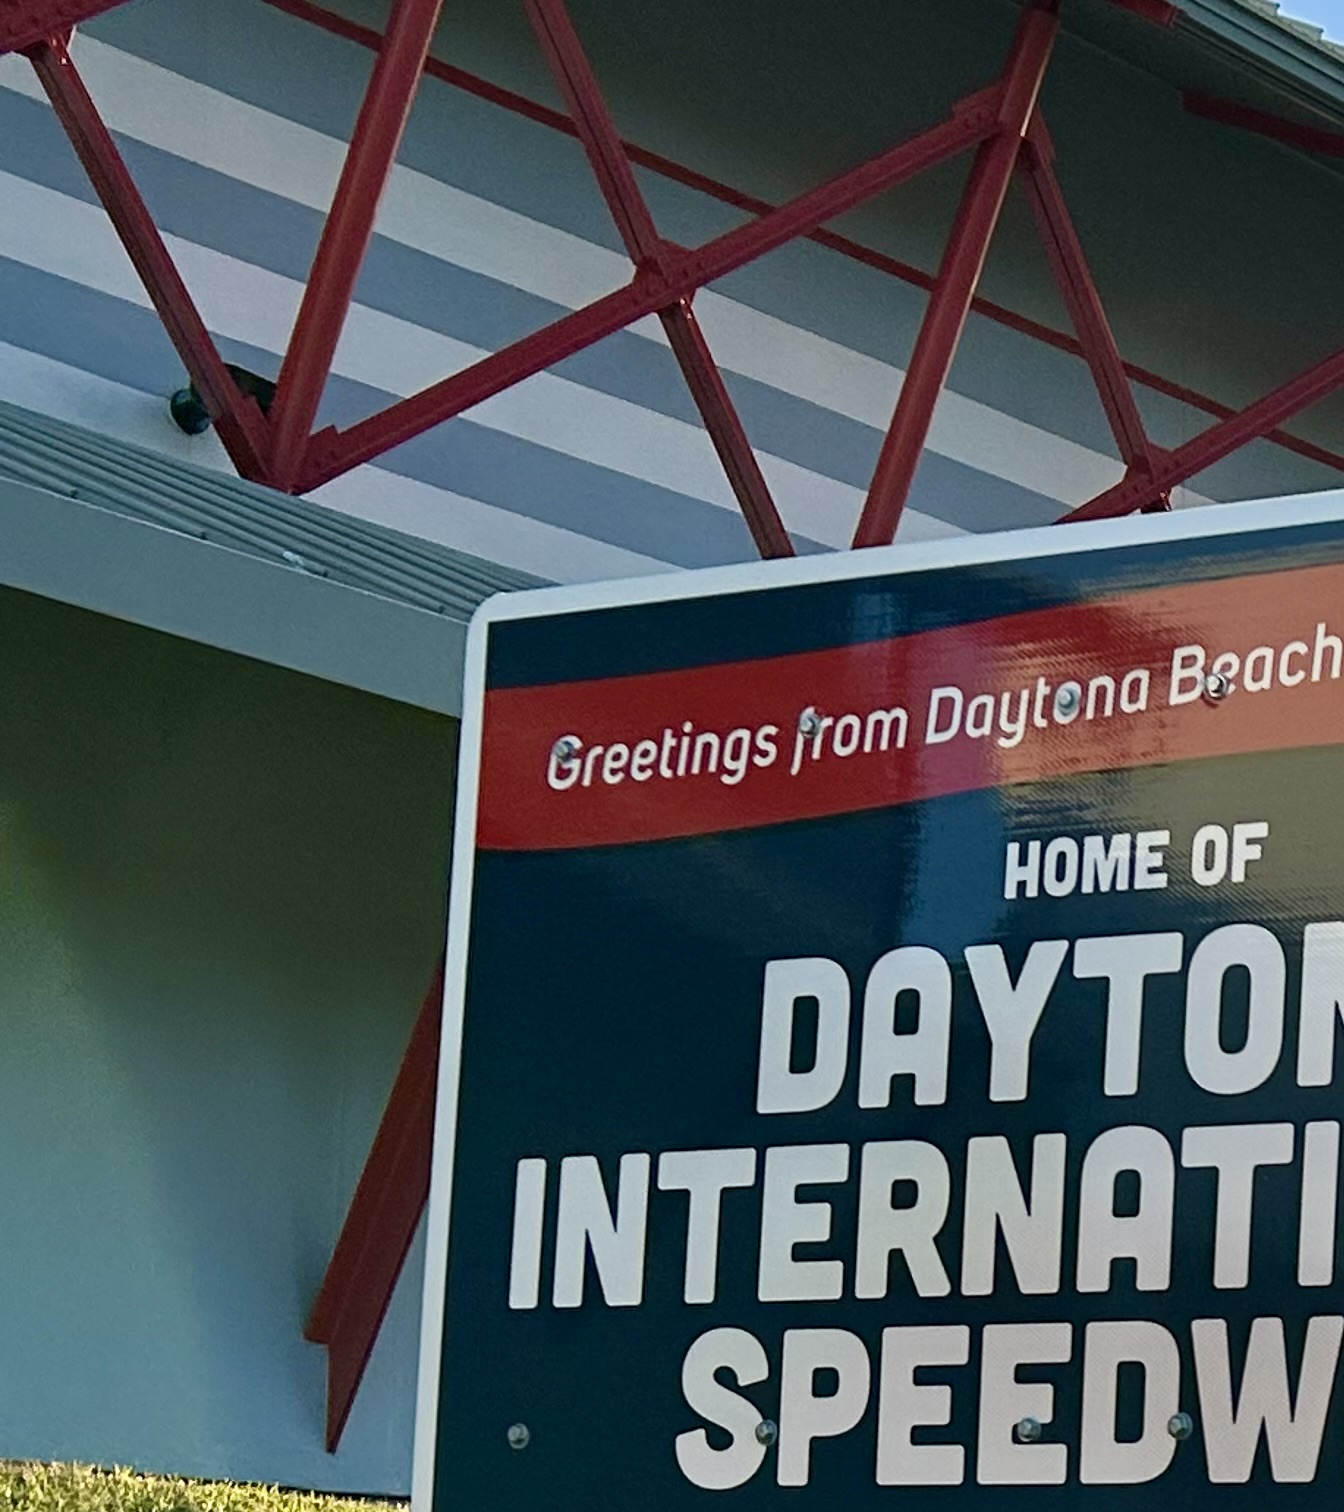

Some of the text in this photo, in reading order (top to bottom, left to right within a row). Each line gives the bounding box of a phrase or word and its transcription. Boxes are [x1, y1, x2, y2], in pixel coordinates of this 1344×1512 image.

[547, 621, 1344, 790] Greetings from Daytona Beach
[1003, 821, 1269, 900] HOME OF
